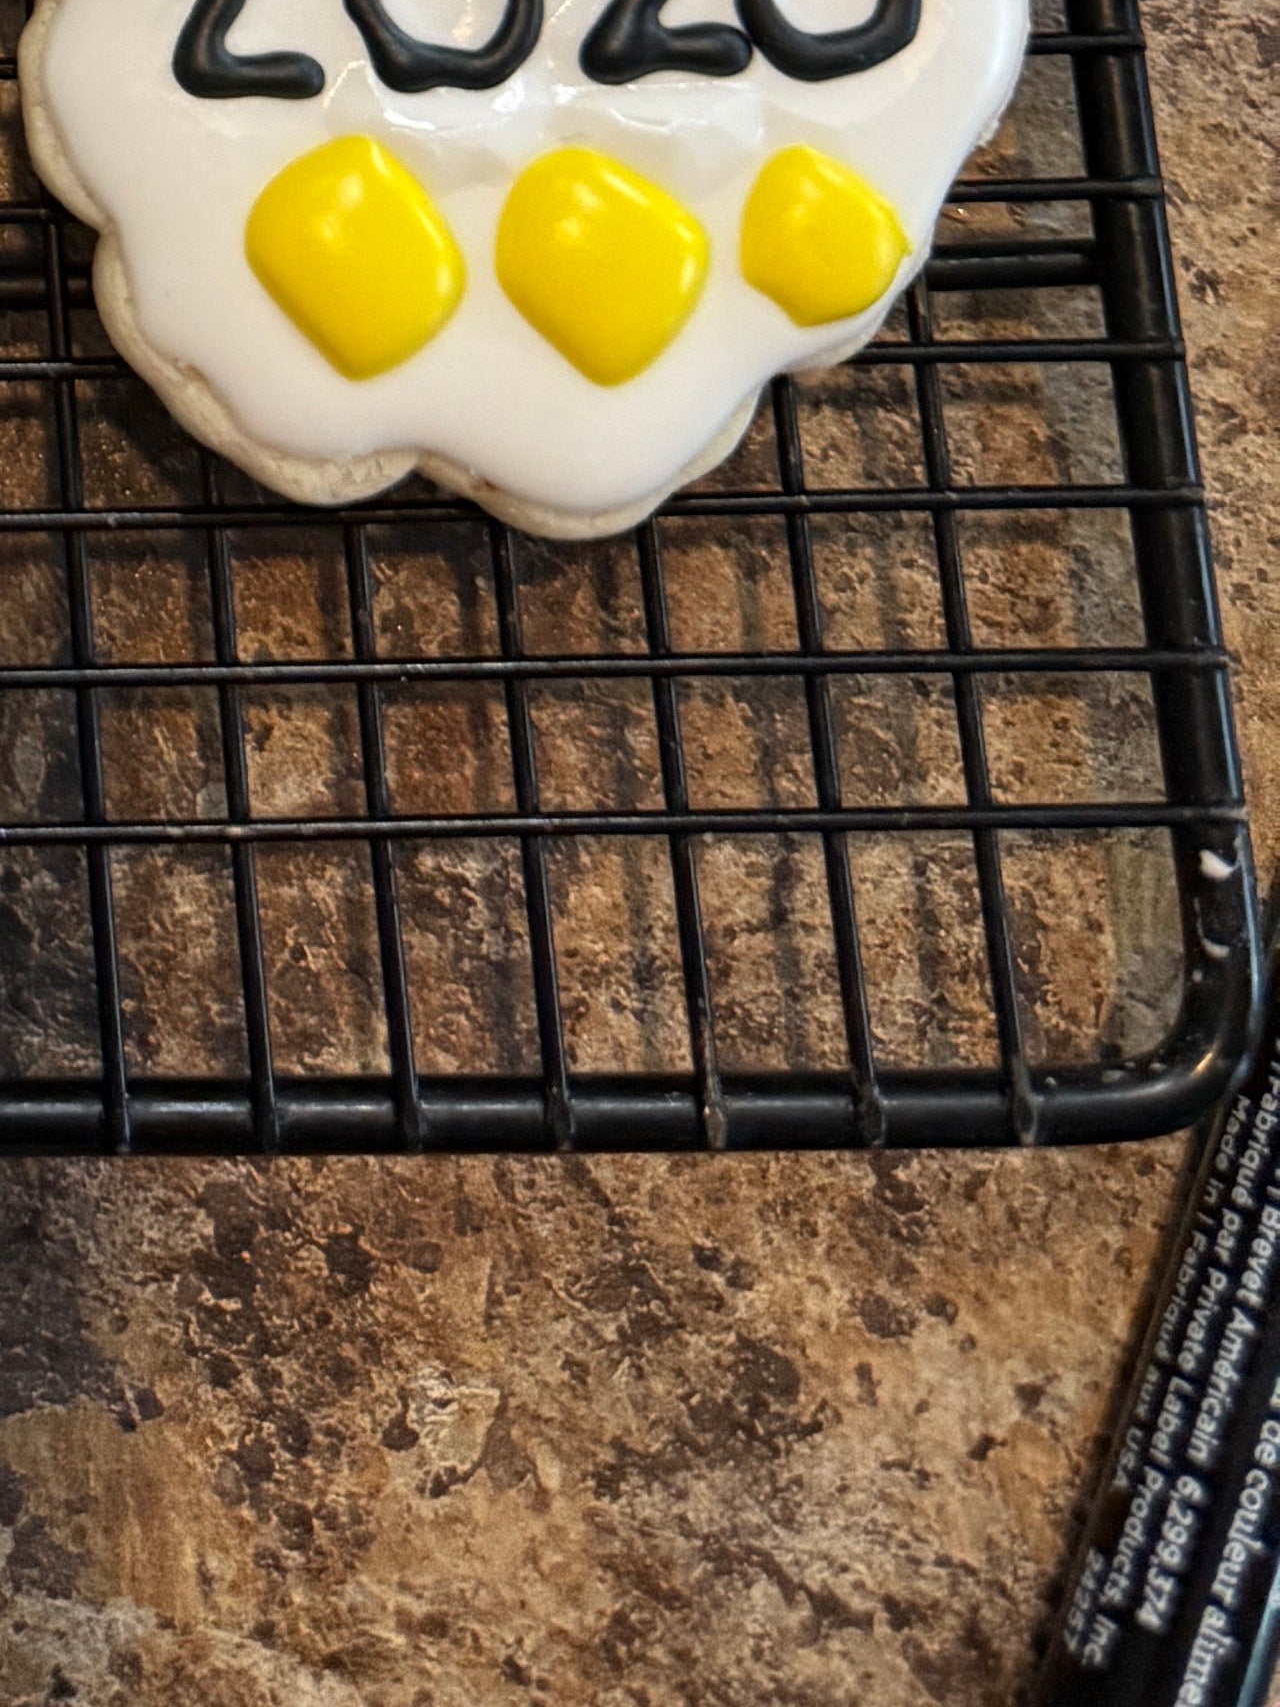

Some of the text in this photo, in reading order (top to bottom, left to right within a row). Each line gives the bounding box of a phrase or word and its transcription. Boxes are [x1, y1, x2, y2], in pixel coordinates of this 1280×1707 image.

[1215, 1094, 1251, 1171] Made
[1203, 1178, 1224, 1205] in
[1214, 1208, 1242, 1263] par
[1236, 1205, 1280, 1306] Brevet
[1177, 1267, 1228, 1373] Private
[1149, 1376, 1193, 1465] Label
[1099, 1466, 1165, 1604] Products,
[1137, 1475, 1203, 1629] 6,299,374
[1211, 1468, 1270, 1606] couleur
[1082, 1614, 1117, 1664] Inc.
[1173, 1605, 1233, 1707] alime
